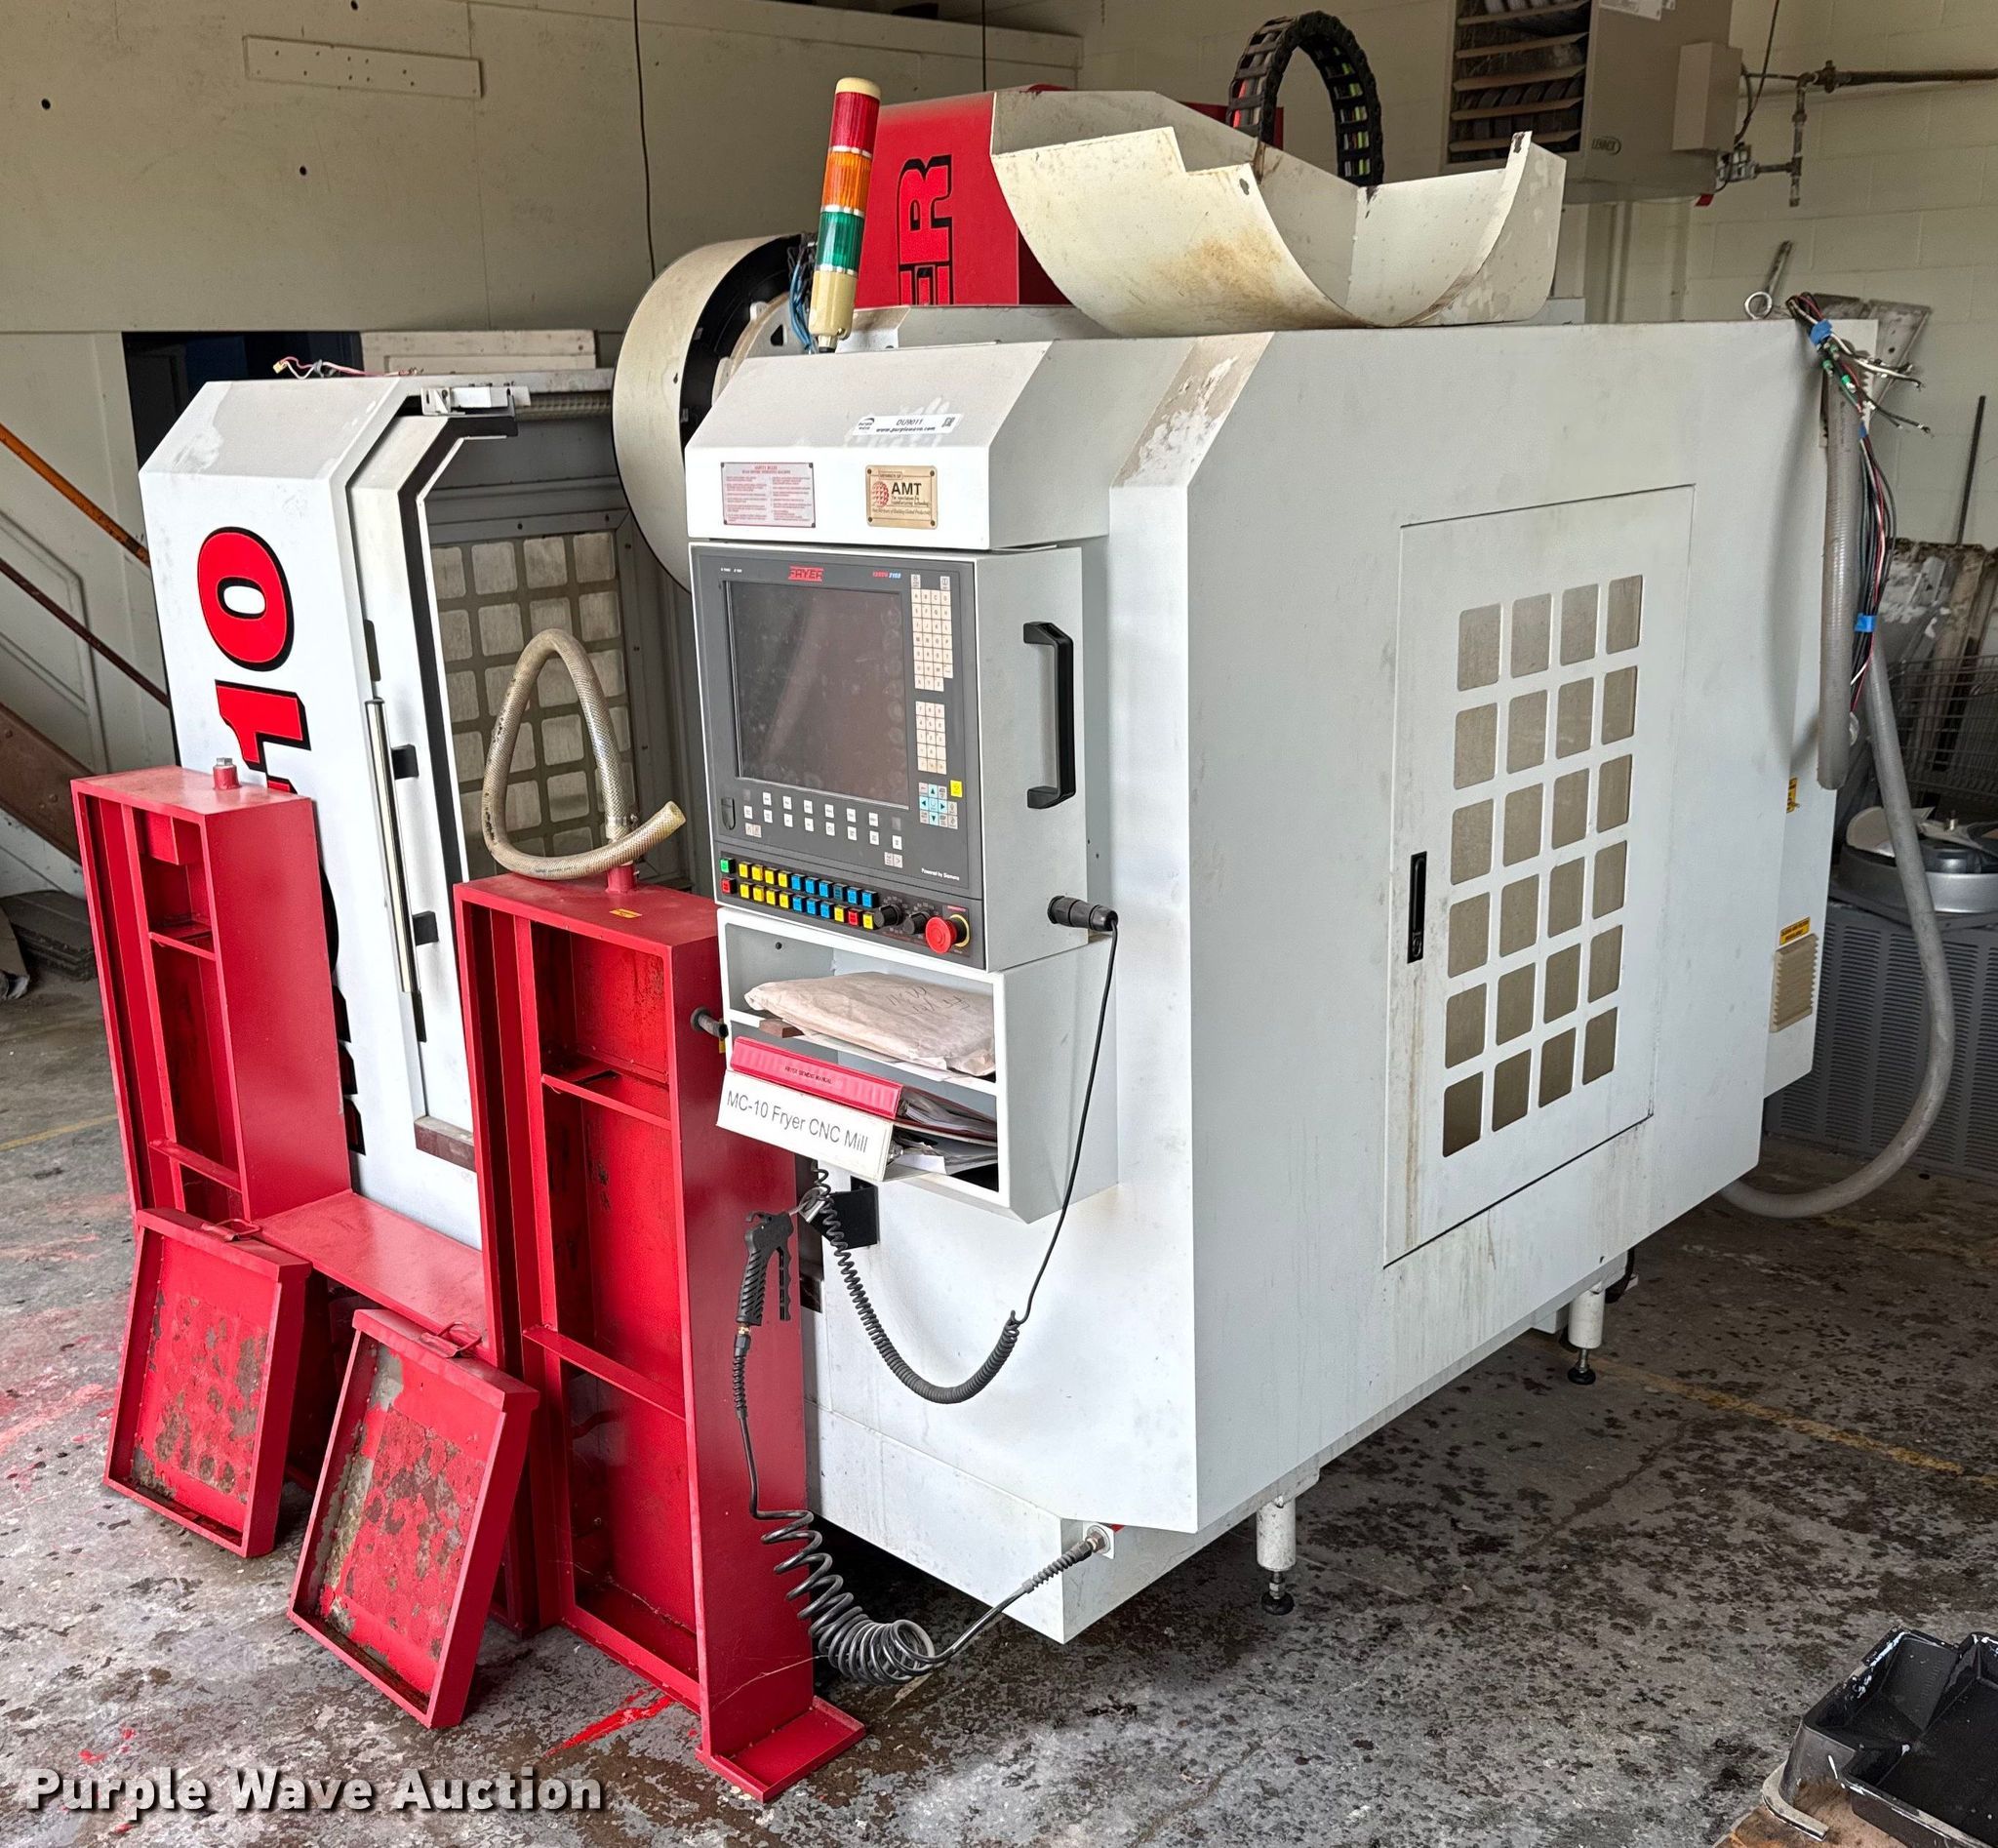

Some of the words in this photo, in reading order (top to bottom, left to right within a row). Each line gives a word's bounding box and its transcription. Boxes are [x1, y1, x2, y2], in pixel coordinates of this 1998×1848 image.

[892, 482, 922, 495] AMT
[727, 1090, 769, 1118] MC-10
[772, 1105, 806, 1130] Fryer
[809, 1118, 840, 1143] CNC
[844, 1130, 868, 1153] Mill
